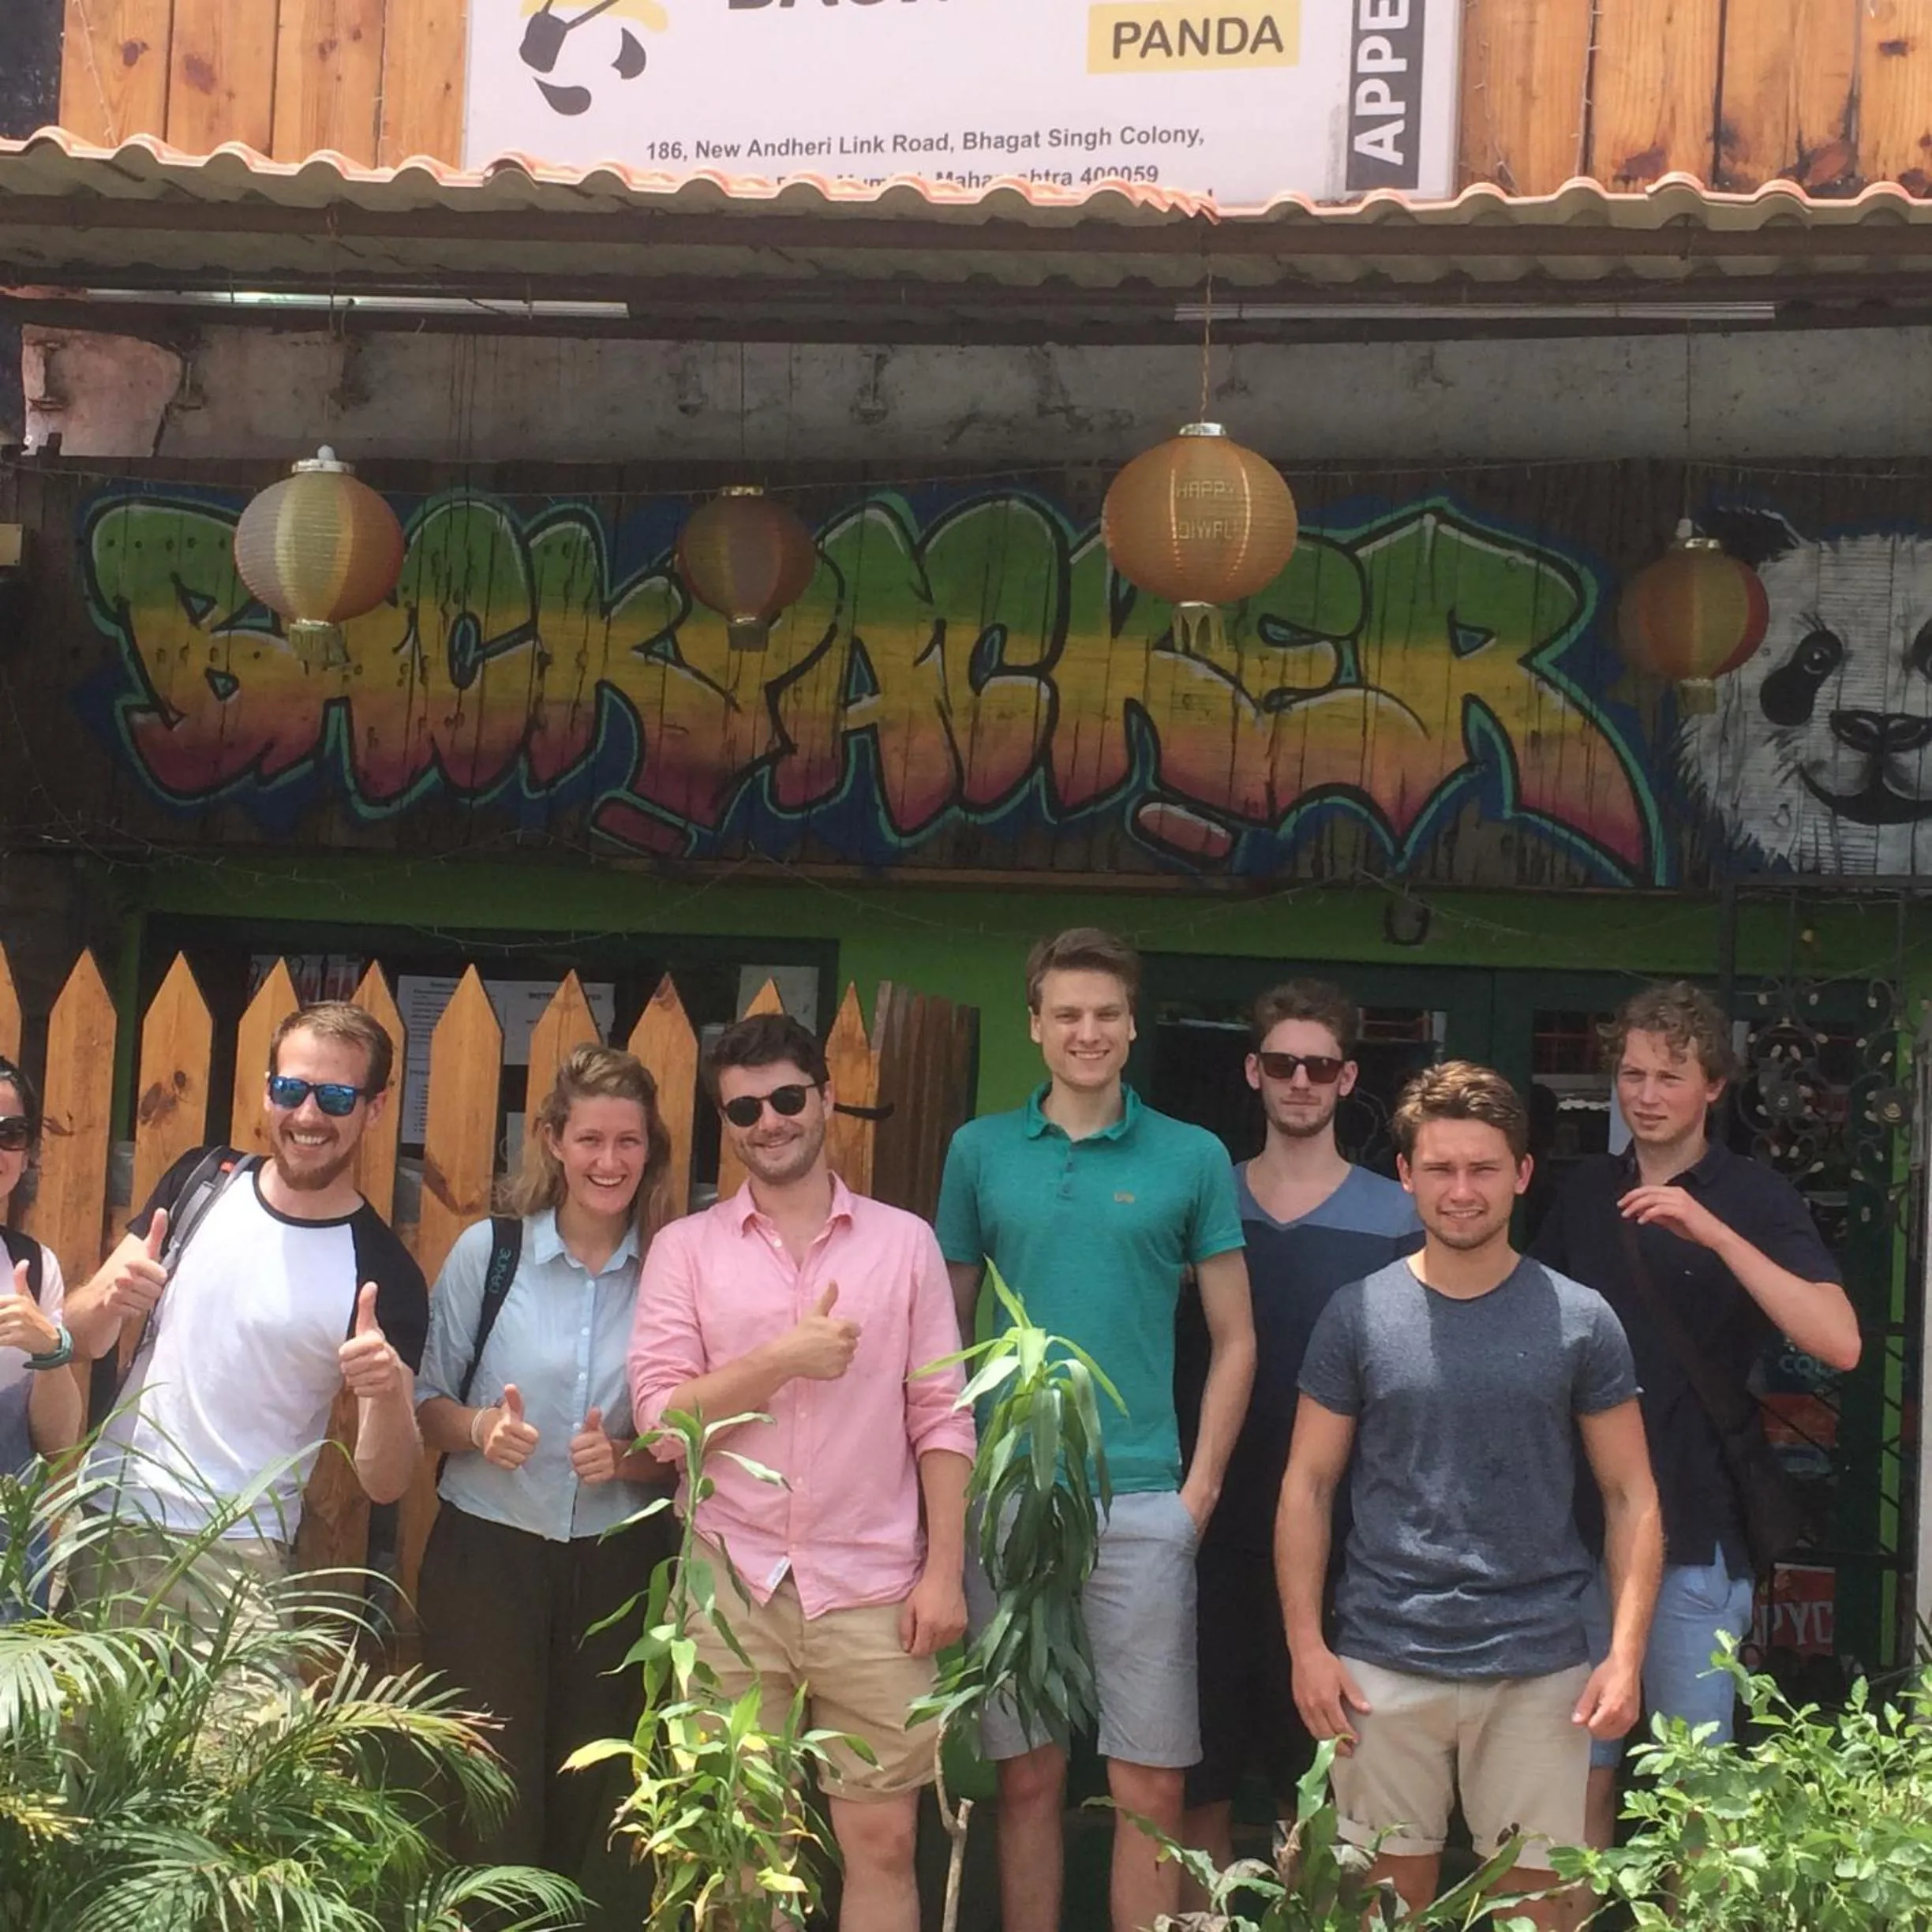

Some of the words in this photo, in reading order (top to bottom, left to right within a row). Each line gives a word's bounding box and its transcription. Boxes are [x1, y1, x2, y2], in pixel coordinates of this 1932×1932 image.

[1113, 15, 1284, 59] PANDA
[647, 141, 687, 162] 186,
[695, 140, 741, 159] New
[747, 137, 831, 157] Andheri
[839, 135, 885, 154] Link
[893, 133, 954, 153] Road,
[963, 131, 1040, 154] Bhagat
[1047, 127, 1112, 152] Singh
[1120, 125, 1205, 148] Colony,
[935, 168, 1073, 190] Mahahtra
